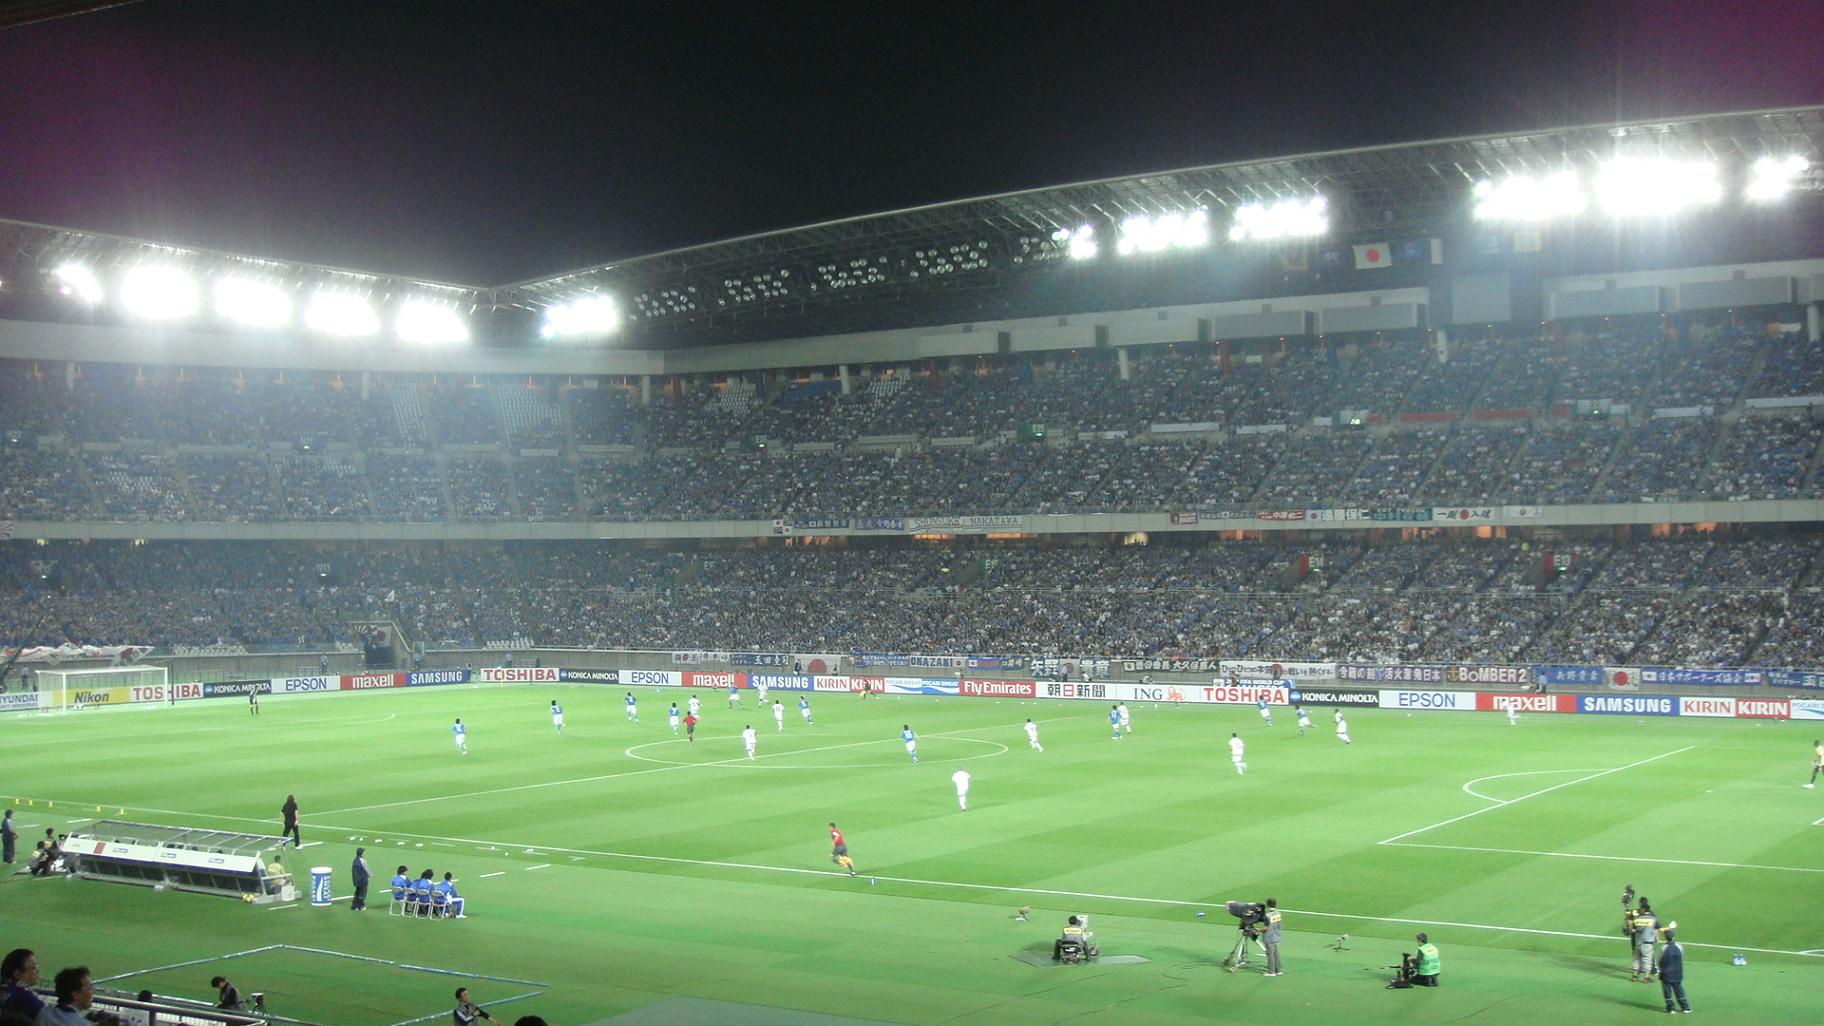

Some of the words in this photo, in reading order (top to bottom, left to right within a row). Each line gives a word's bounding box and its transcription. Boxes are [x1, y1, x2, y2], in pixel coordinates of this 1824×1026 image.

[910, 656, 953, 667] OKAZAKI
[352, 674, 394, 689] maxell
[411, 671, 463, 685] SAMSUNG
[483, 669, 557, 681] TOSHIBA
[568, 671, 592, 680] KONICA
[592, 672, 618, 681] MINOLTA
[631, 671, 669, 684] EPSON
[693, 673, 735, 688] maxell
[752, 675, 809, 689] SAMSUNG
[214, 684, 241, 694] KONICA
[285, 678, 327, 692] EPSON
[816, 678, 848, 690] KIRIN
[964, 681, 982, 695] Fly
[983, 681, 1032, 695] Emirates
[1047, 683, 1106, 698] 朝日新聞
[74, 692, 110, 704] Nikon
[1134, 688, 1163, 700] ING
[1203, 687, 1285, 703] TOSHIBA
[1302, 692, 1337, 702] KONICA
[1337, 693, 1379, 703] MINOLTA
[1399, 692, 1456, 708] EPSON
[1584, 696, 1671, 713] SAMSUNG
[1685, 700, 1731, 714] KIRIN
[1738, 701, 1788, 716] KIRIN
